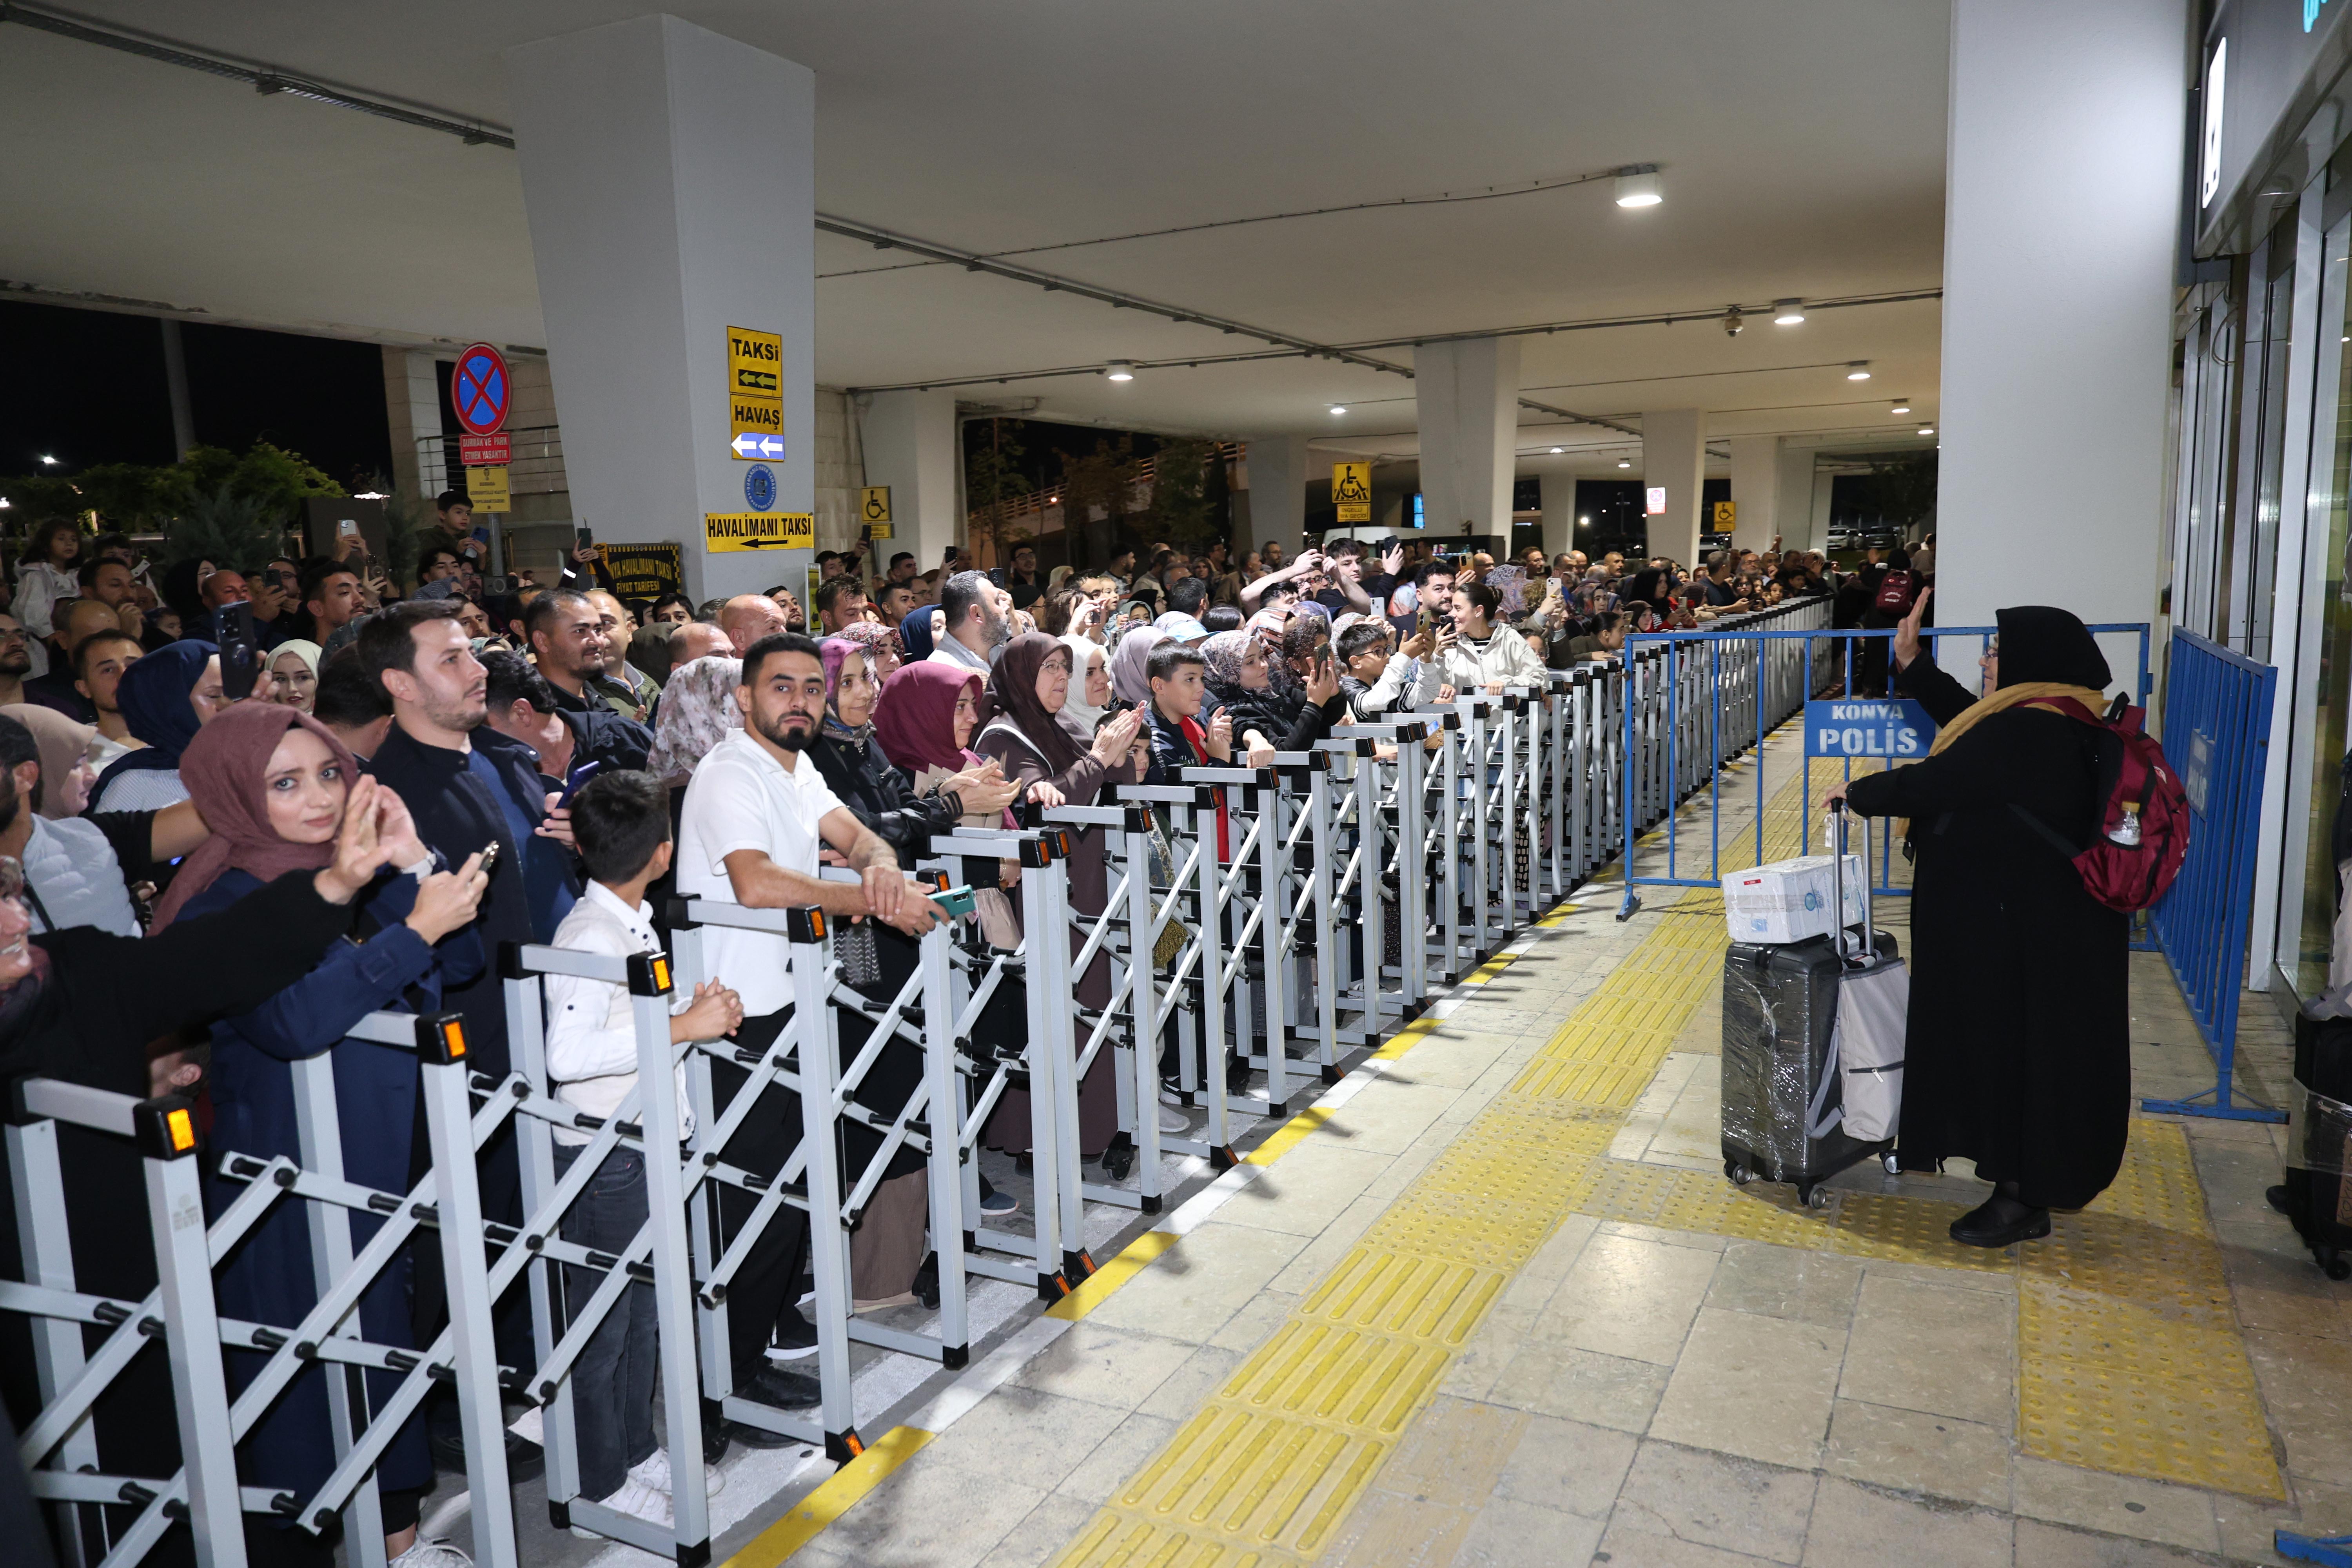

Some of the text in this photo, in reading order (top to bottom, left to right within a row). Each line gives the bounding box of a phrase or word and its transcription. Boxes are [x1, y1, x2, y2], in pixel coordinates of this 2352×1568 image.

[735, 405, 780, 430] HAVAŞ
[463, 436, 508, 447] DURMAK VE PARK
[465, 450, 508, 460] ETMEK YASAKTIR
[708, 514, 811, 537] HAVALİMANI TAKSİ
[609, 561, 622, 581] NYA
[621, 554, 655, 577] HAVALİMANI
[655, 560, 673, 581] TAKSİ
[616, 578, 661, 593] FİYAT TARİFESİ
[1832, 705, 1904, 720] KONYA
[1820, 722, 1918, 754] POLİS
